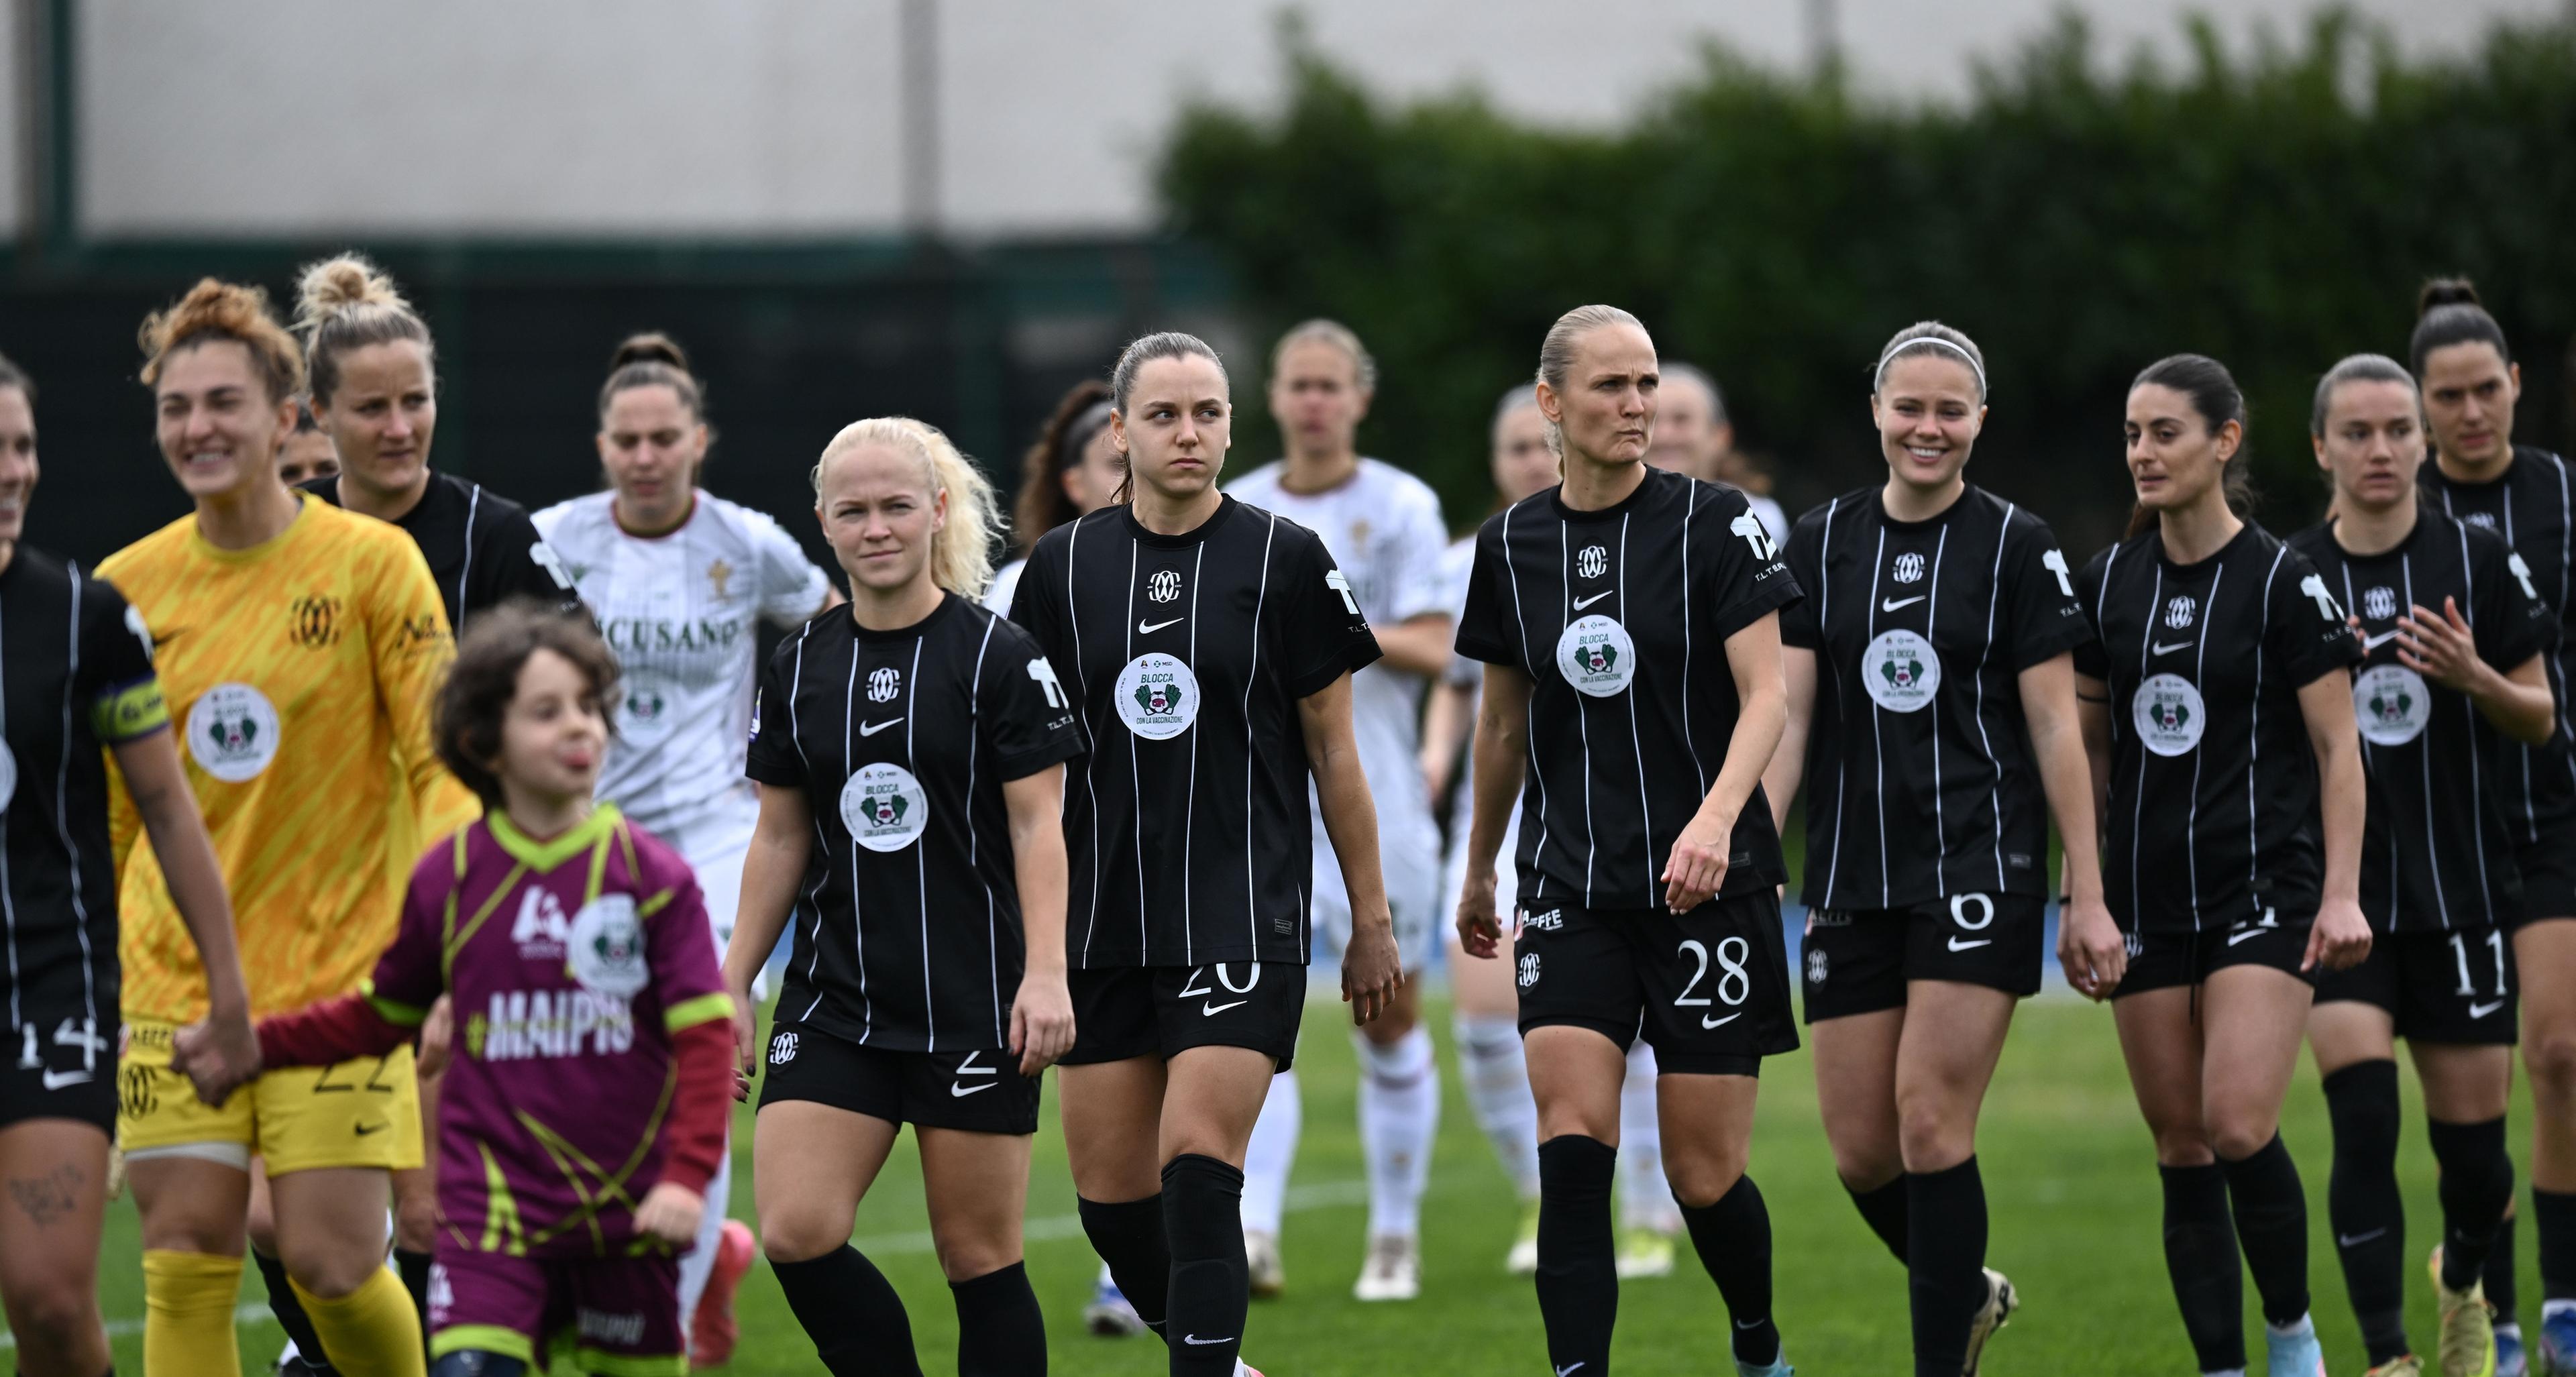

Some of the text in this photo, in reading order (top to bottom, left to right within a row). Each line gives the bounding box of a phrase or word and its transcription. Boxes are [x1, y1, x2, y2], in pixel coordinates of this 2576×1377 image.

[1579, 633, 1609, 645] BLOCCA
[1140, 673, 1173, 683] BLOCCA
[1580, 676, 1589, 684] CON
[1152, 716, 1183, 724] VACCINAZIONE
[865, 783, 899, 795] BLOCCA
[2447, 928, 2508, 996] 11
[1674, 936, 1750, 1006] 28
[16, 1016, 109, 1072] 14
